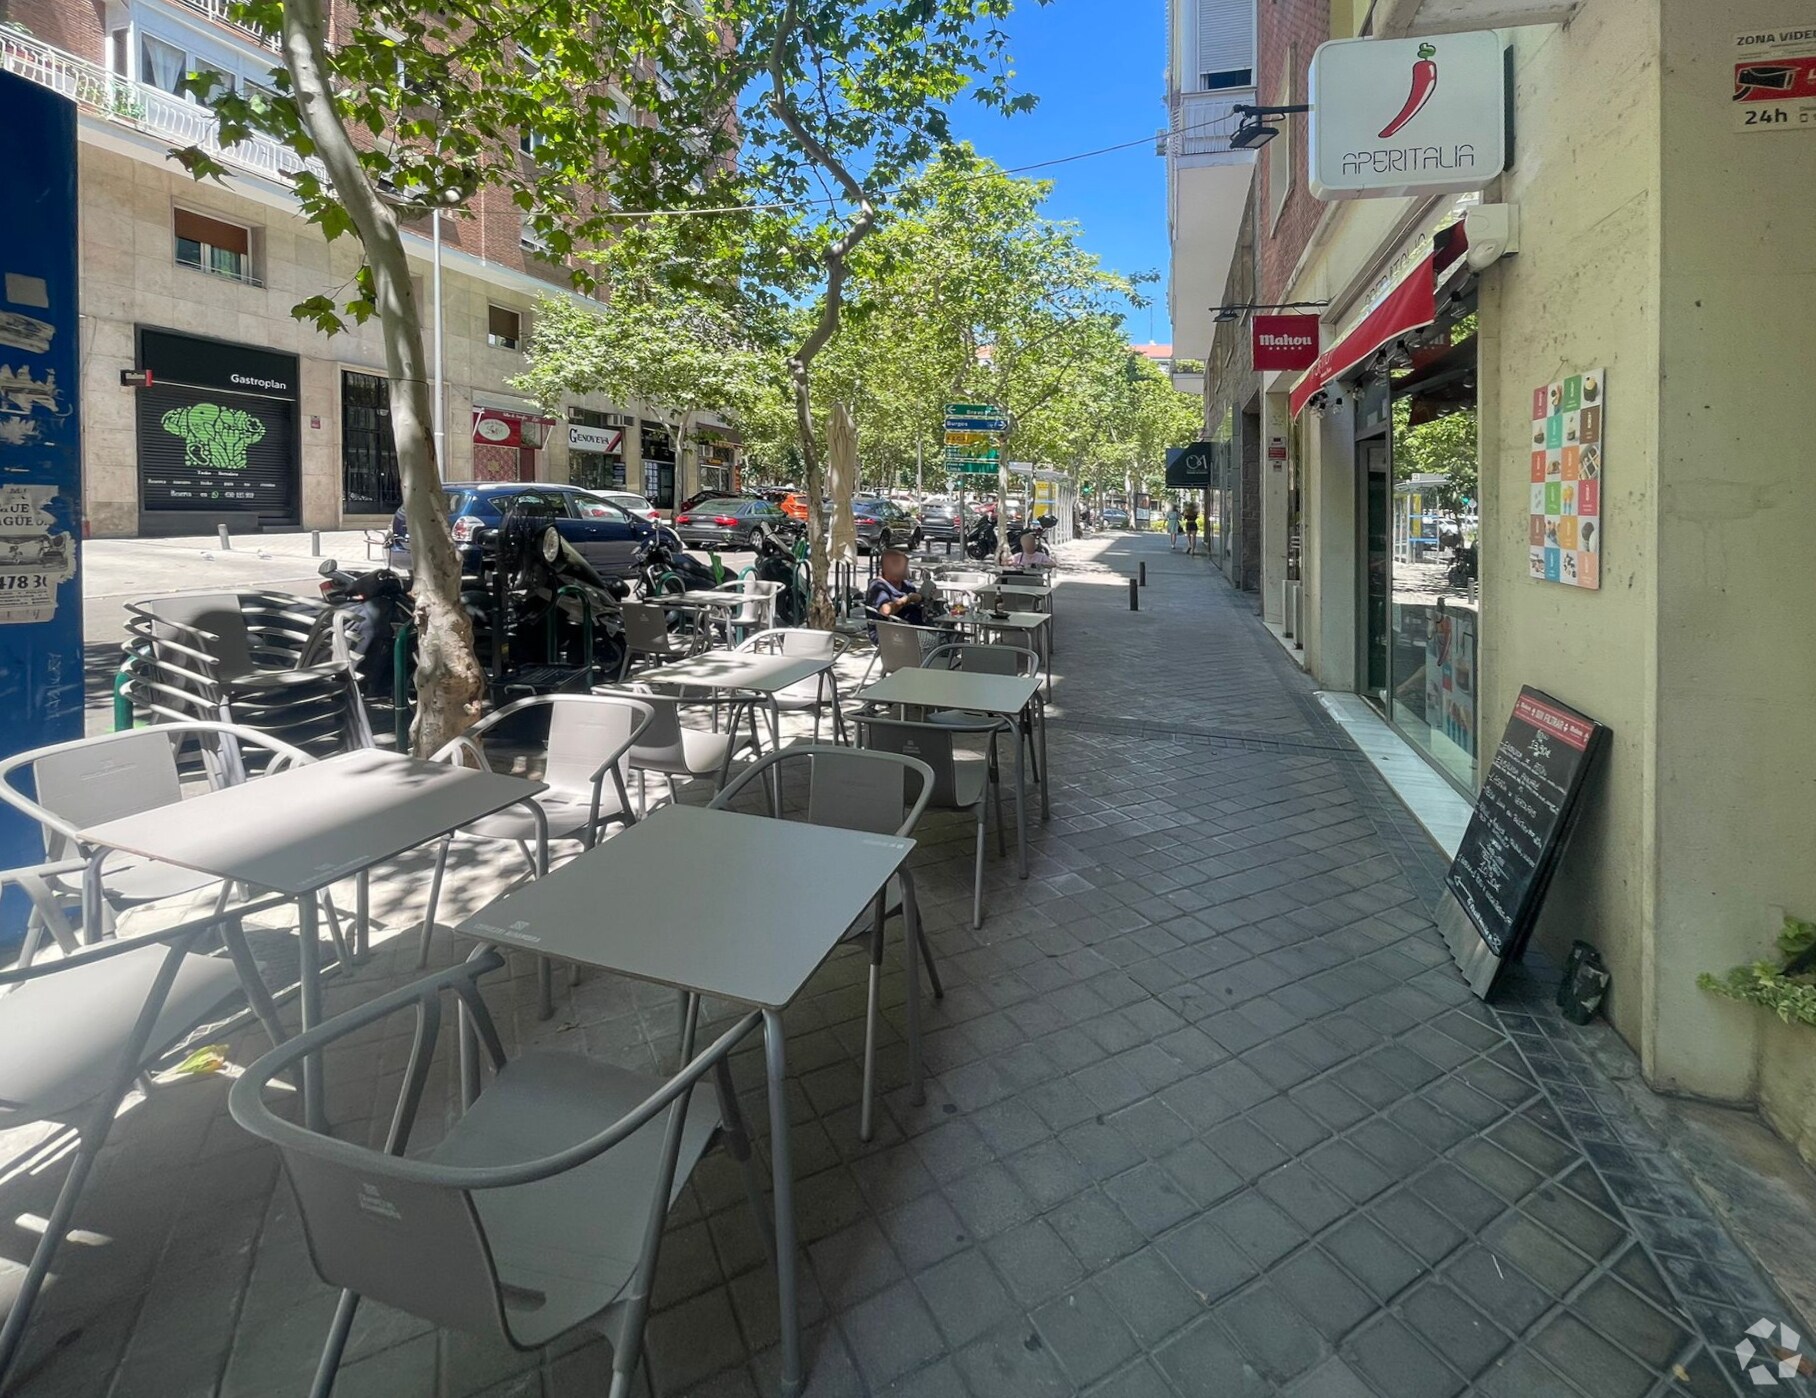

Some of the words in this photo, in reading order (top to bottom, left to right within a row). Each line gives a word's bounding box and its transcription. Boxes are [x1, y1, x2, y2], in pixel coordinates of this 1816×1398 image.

[1737, 34, 1776, 46] ZONA
[1744, 108, 1788, 125] 24h
[1342, 144, 1475, 175] APERITALIA
[1259, 333, 1313, 346] Mahou
[230, 374, 287, 390] Gastroplan
